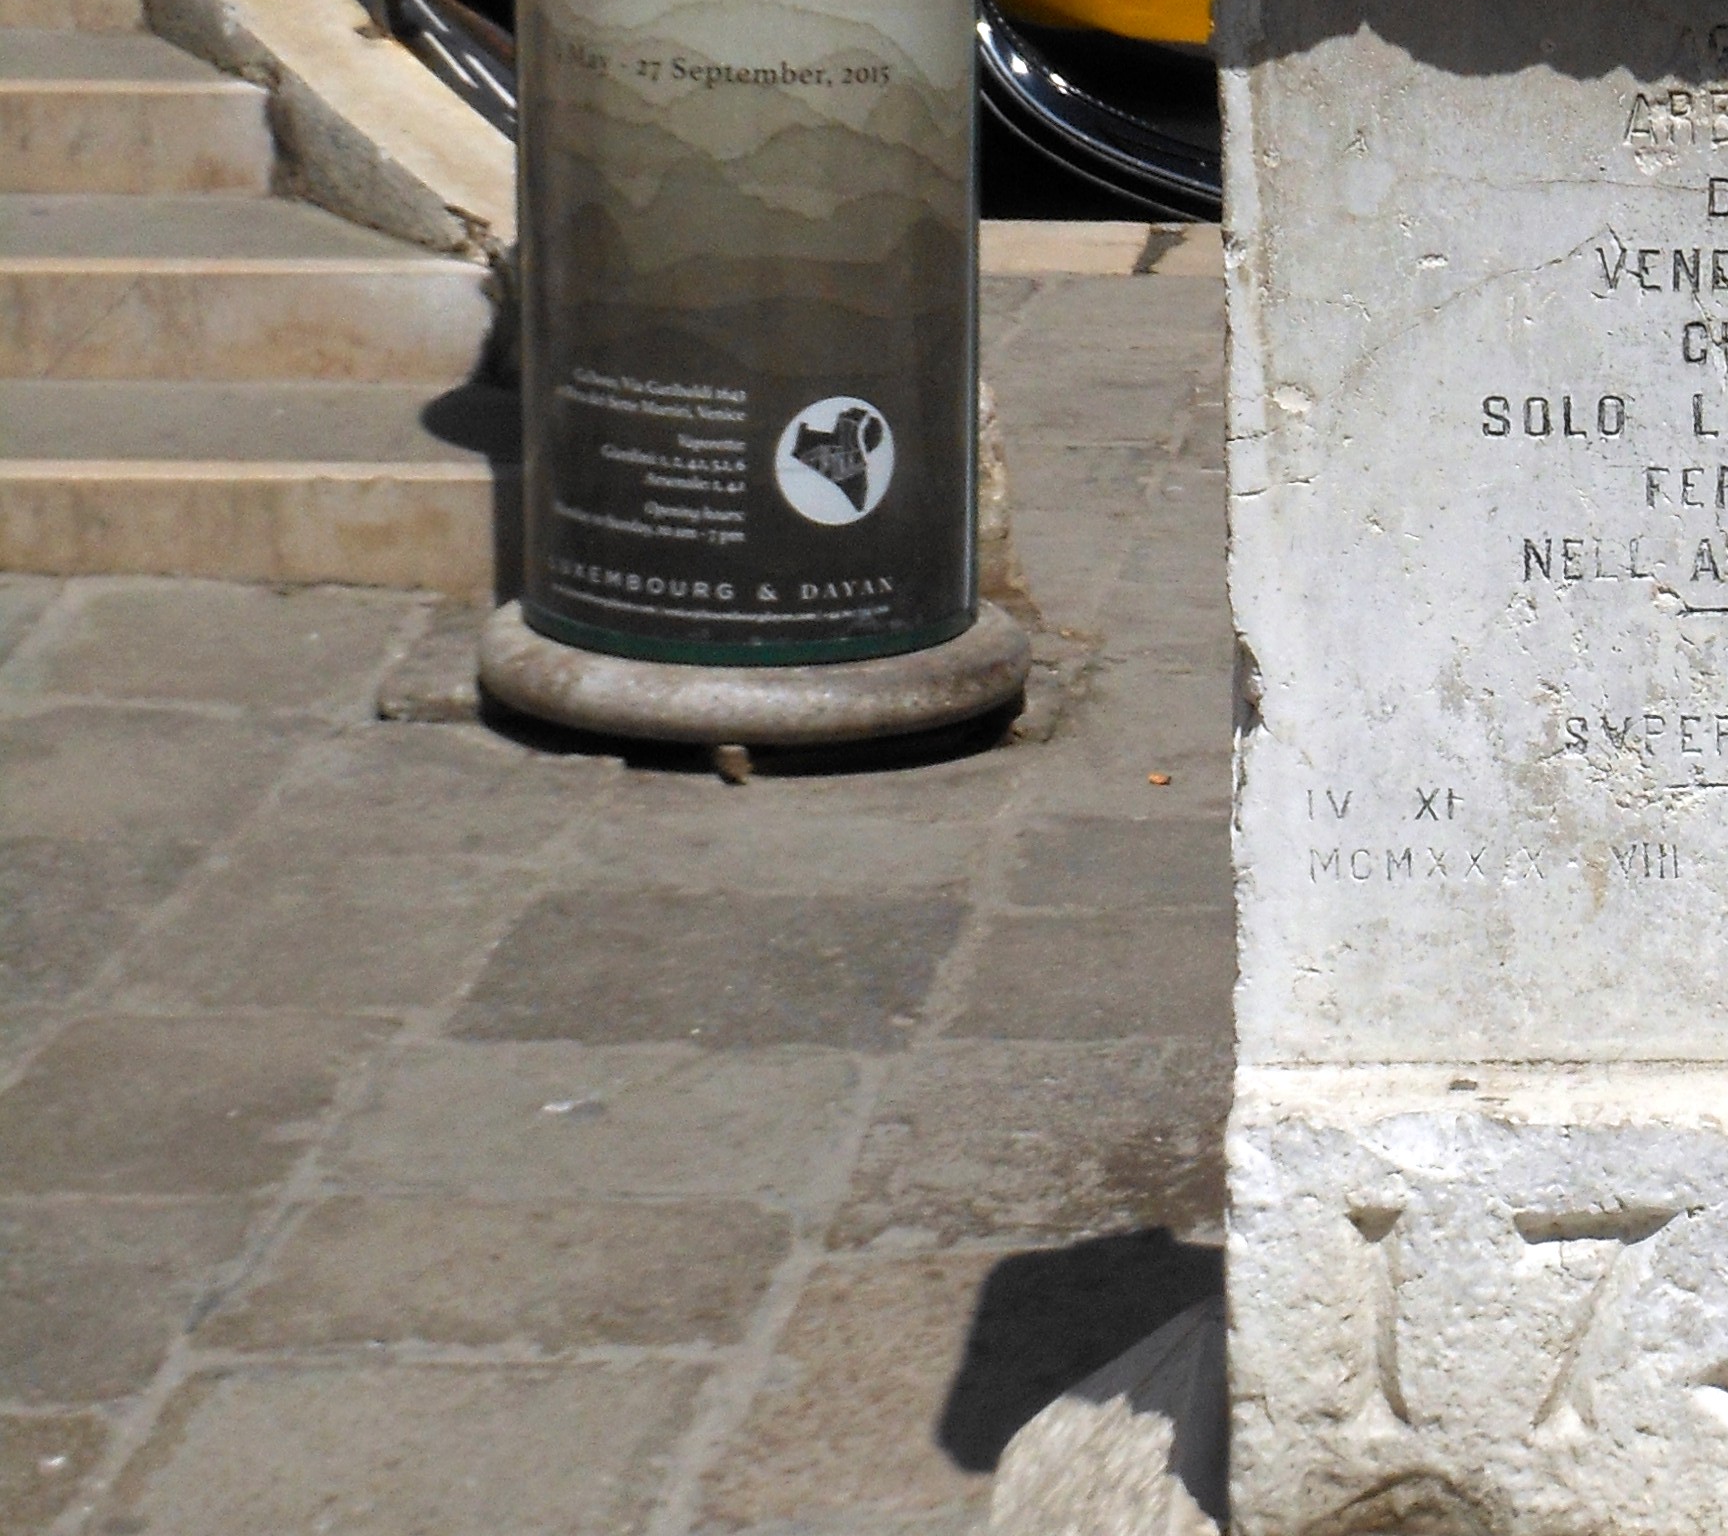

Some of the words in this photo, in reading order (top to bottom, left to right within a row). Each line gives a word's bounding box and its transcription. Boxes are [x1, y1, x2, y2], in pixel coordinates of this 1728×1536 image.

[670, 54, 833, 92] September,
[840, 64, 891, 87] 2015
[1481, 394, 1627, 439] SOLO
[1522, 537, 1655, 584] NELL
[756, 582, 779, 602] &
[1306, 787, 1355, 821] IV
